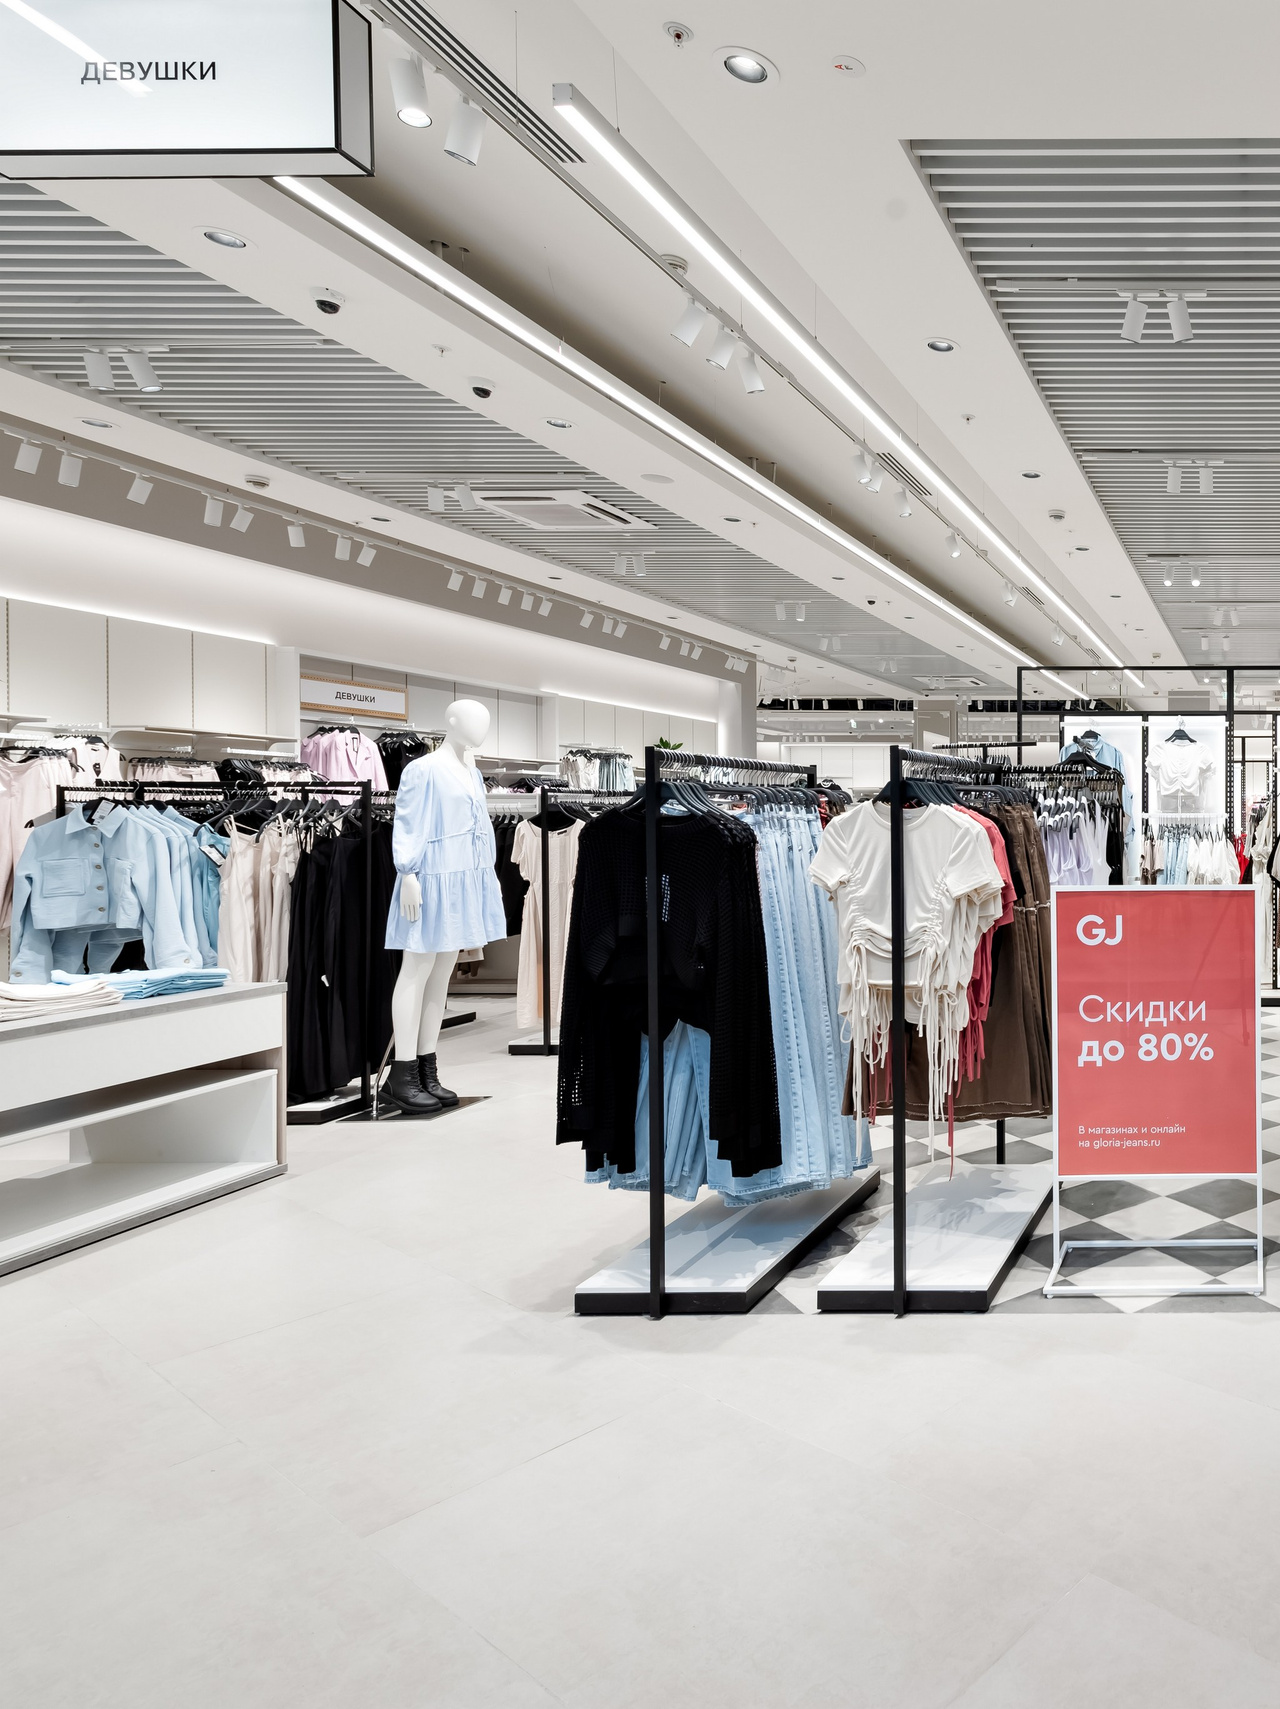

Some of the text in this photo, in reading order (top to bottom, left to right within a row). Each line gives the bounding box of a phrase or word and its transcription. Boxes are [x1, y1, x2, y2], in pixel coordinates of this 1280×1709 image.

[80, 61, 216, 85] ДЕВУШКИ
[335, 691, 376, 703] ДЕВУШКИ
[1076, 914, 1123, 946] GJ
[1078, 994, 1206, 1027] Скидки
[1077, 1032, 1214, 1067] до 80%
[1078, 1125, 1085, 1134] В
[1088, 1126, 1138, 1134] магазинах
[1150, 1123, 1186, 1134] онлайн
[1078, 1138, 1161, 1149] на gloria-jeans.ru
